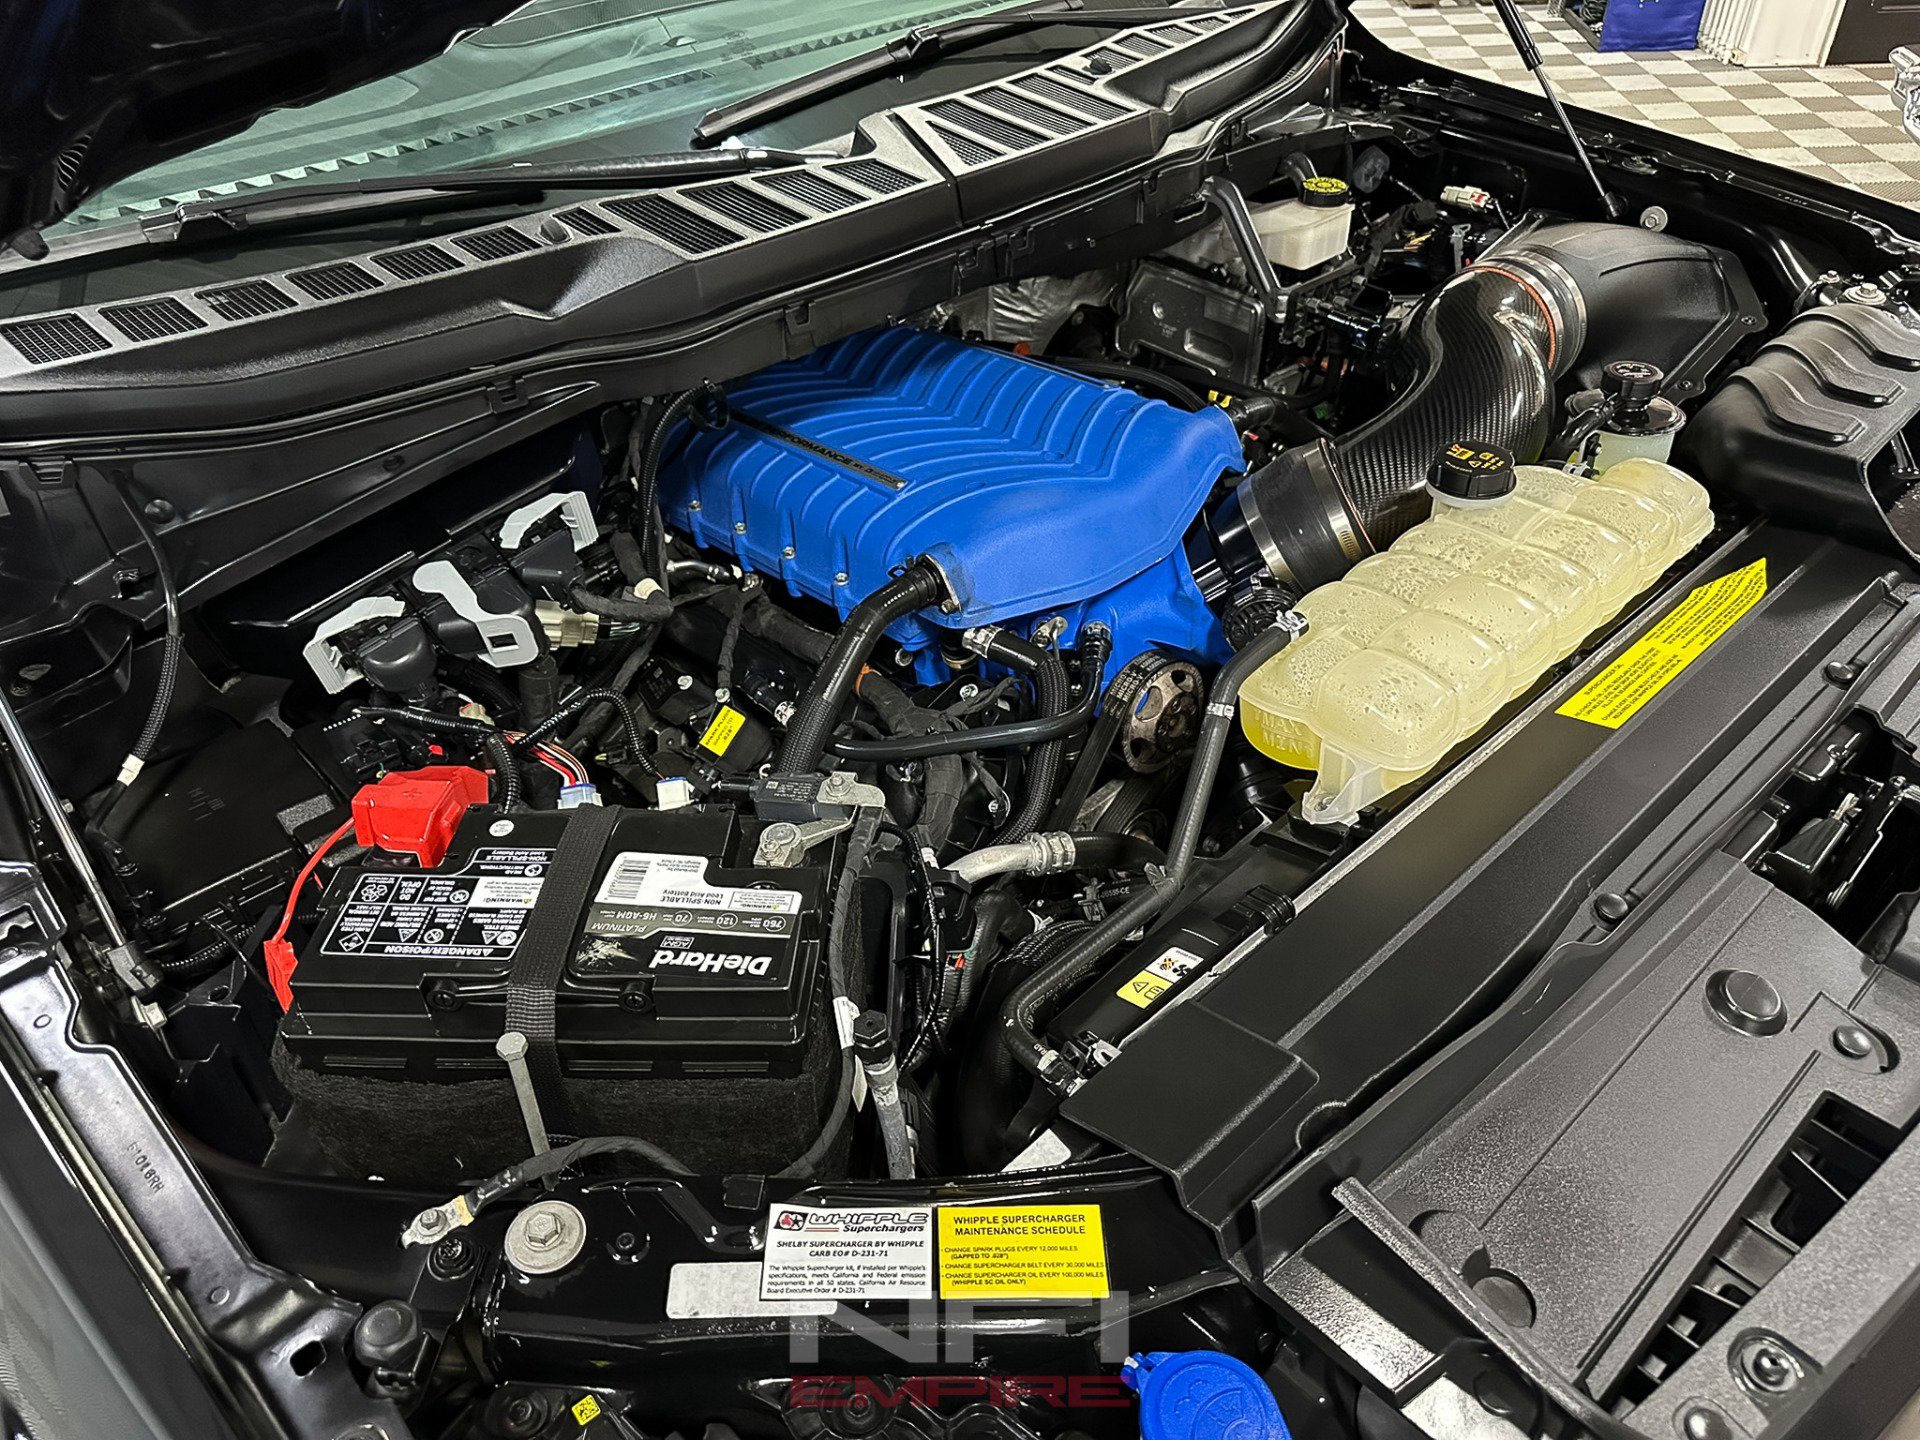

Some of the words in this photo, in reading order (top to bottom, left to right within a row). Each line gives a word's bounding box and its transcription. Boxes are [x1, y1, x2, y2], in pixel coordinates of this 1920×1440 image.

[1263, 732, 1300, 755] MIN
[660, 896, 721, 905] NON-SPILLABLE
[675, 914, 688, 922] 70
[716, 916, 734, 925] 120
[591, 922, 647, 932] PLATINUM
[763, 920, 782, 928] 760
[384, 946, 482, 956] DANGER/POISON
[649, 950, 772, 975] DieHard
[809, 1213, 929, 1225] WHIPPLE
[953, 1216, 999, 1224] WHIPPLE
[1001, 1215, 1086, 1223] SUPERCHARGER
[843, 1224, 924, 1233] Superchargers
[955, 1227, 1029, 1235] MAINTENANCE
[1031, 1226, 1086, 1234] SCHEDULE
